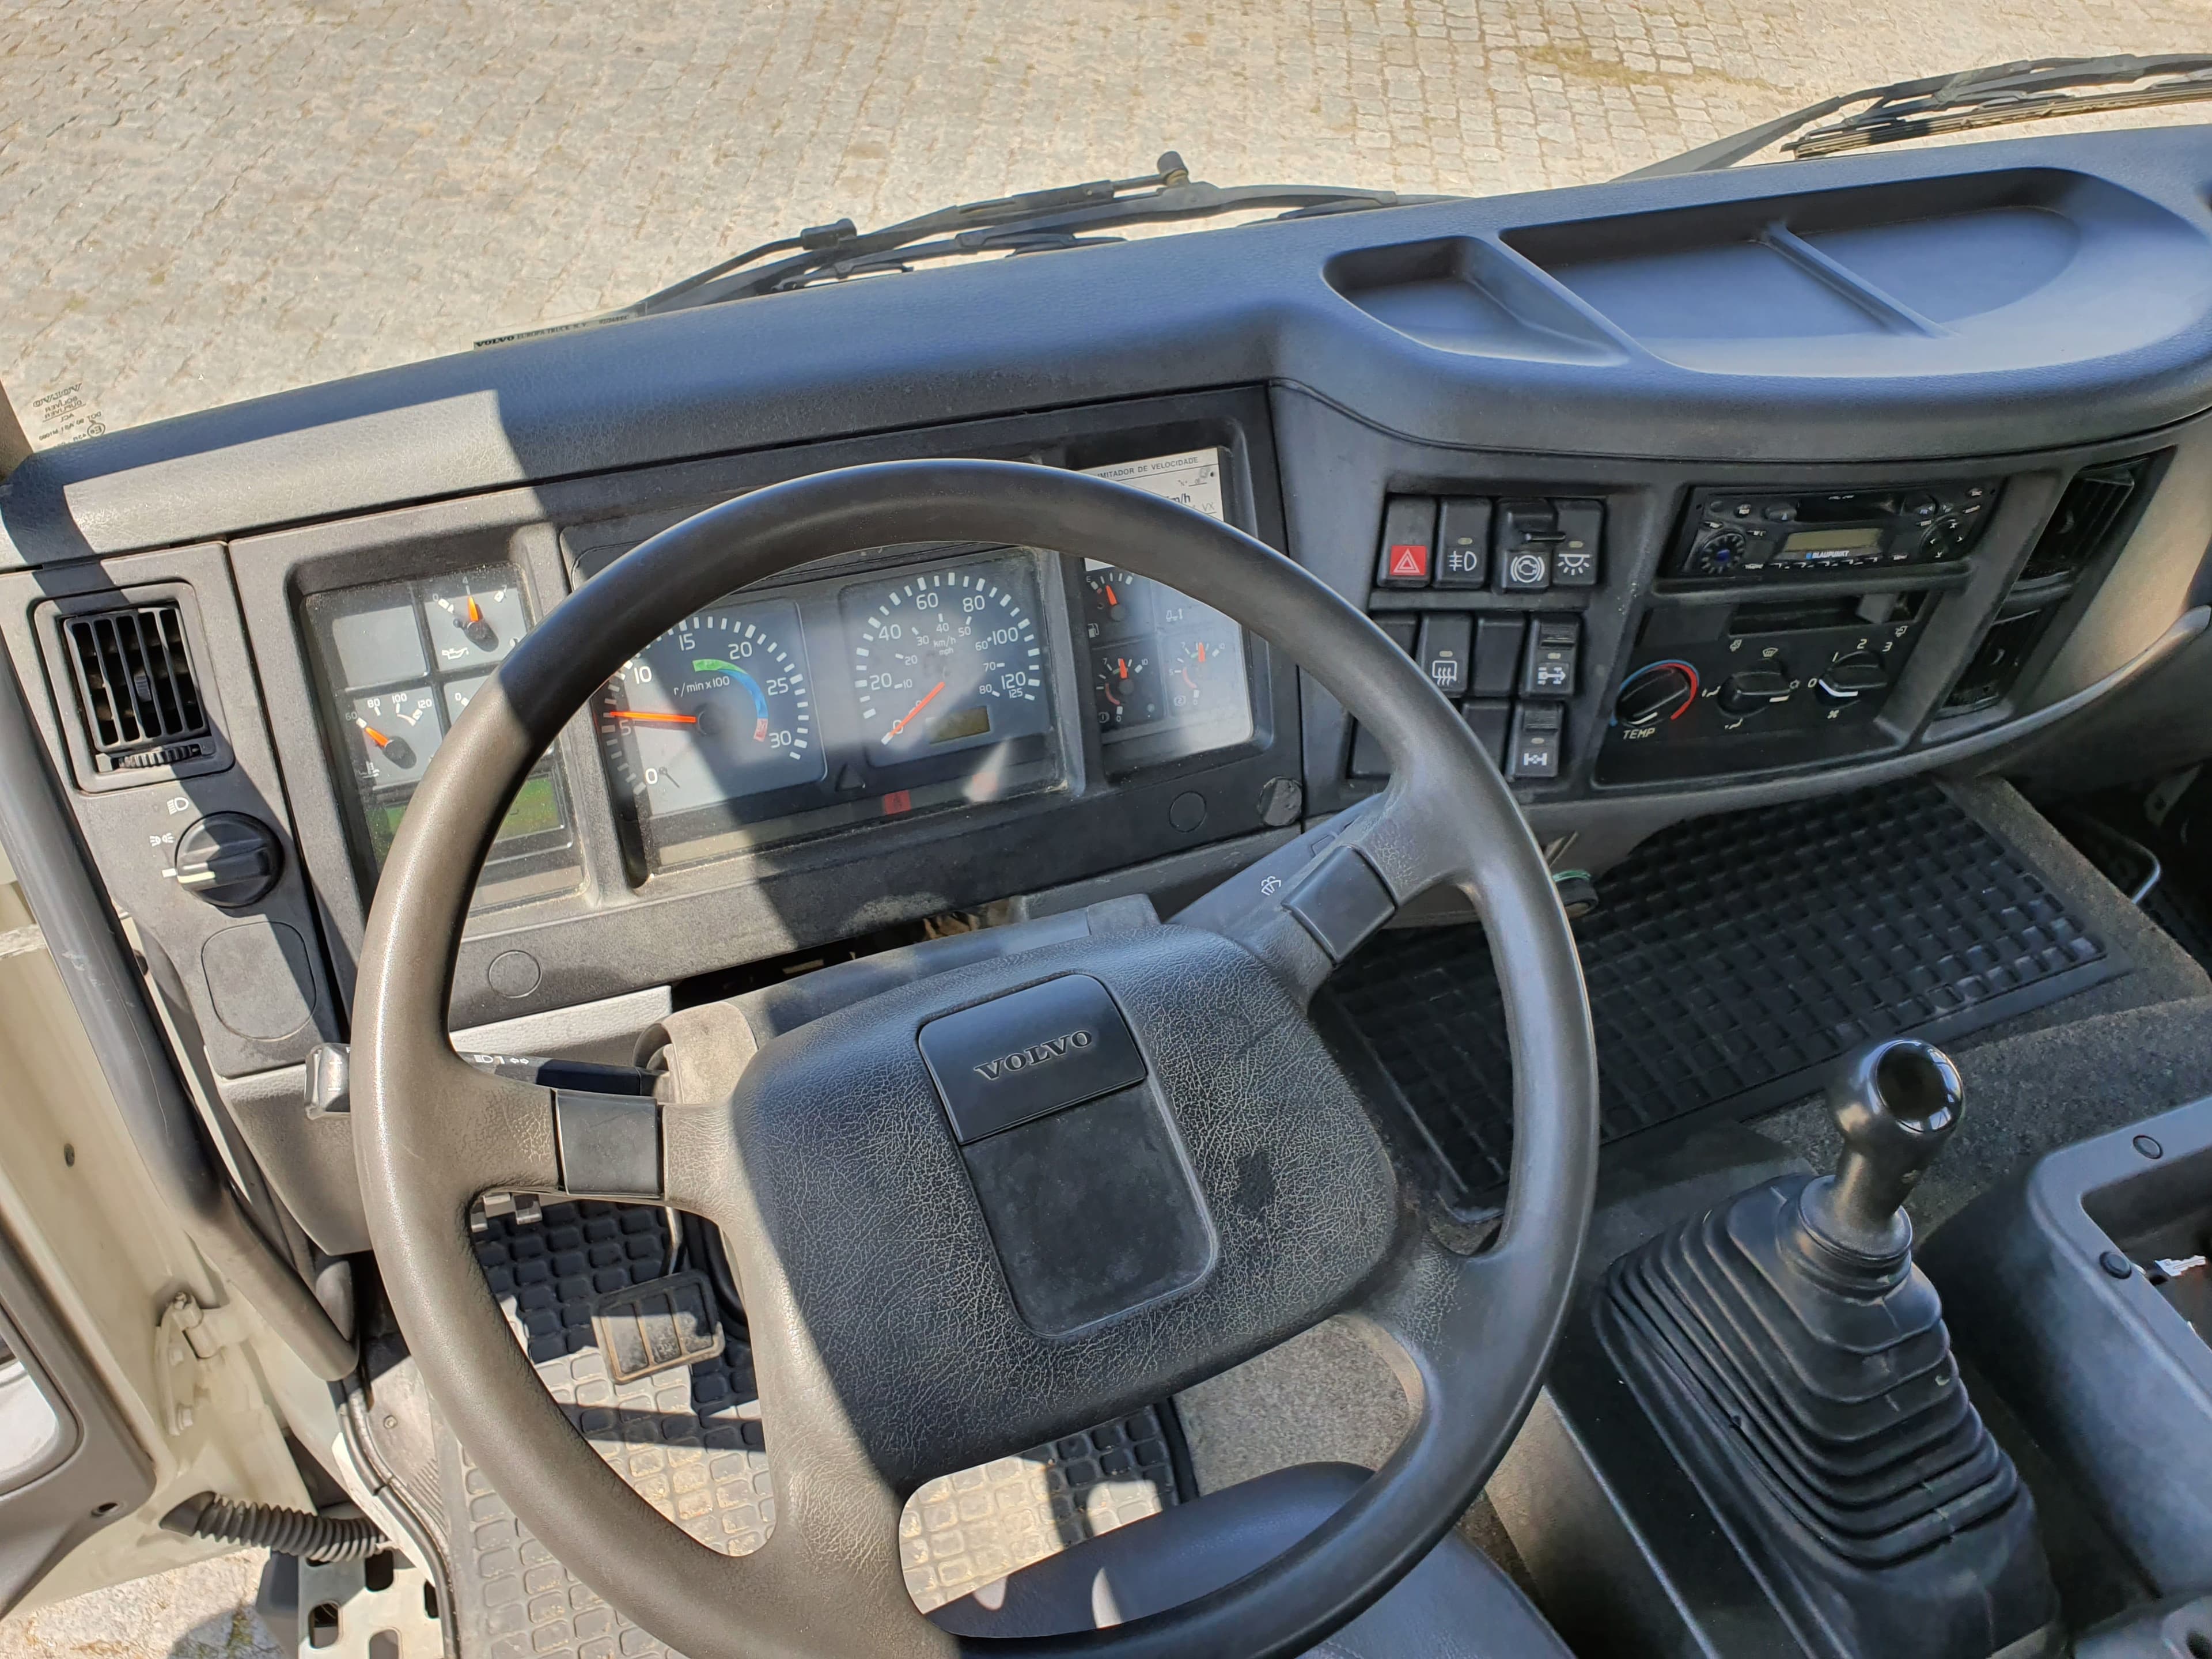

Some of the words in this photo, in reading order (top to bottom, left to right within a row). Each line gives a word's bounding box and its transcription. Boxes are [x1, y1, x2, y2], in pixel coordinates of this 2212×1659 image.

[475, 336, 514, 347] VOLVO
[548, 324, 570, 334] TRUCK
[1097, 467, 1135, 479] IMITADOR
[1152, 456, 1199, 471] VELOCIDADE
[916, 593, 938, 610] 60
[963, 595, 985, 612] 80
[878, 624, 902, 641] 40
[936, 623, 949, 633] 40
[958, 626, 971, 637] 50
[679, 633, 696, 651] 15
[916, 635, 930, 646] 30
[933, 635, 956, 649] km/h
[992, 627, 1018, 645] 100
[728, 641, 753, 660] 20
[975, 641, 988, 651] 60
[1857, 639, 1867, 649] 2
[1882, 642, 1893, 652] 3
[939, 646, 954, 656] mph
[904, 655, 918, 665] 20
[983, 662, 996, 672] 70
[634, 666, 653, 684] 10
[869, 673, 892, 690] 20
[1001, 671, 1026, 690] 120
[766, 677, 789, 696] 25
[903, 679, 913, 689] 10
[979, 684, 993, 694] 80
[392, 693, 408, 704] 100
[454, 692, 462, 701] 0
[1009, 688, 1023, 698] 125
[367, 698, 381, 708] 80
[418, 699, 432, 709] 120
[345, 711, 358, 721] 60
[619, 719, 631, 736] 5
[1623, 727, 1656, 740] TEMP
[769, 730, 791, 748] 30
[645, 767, 658, 785] 0
[974, 1030, 1092, 1081] VOLVO
